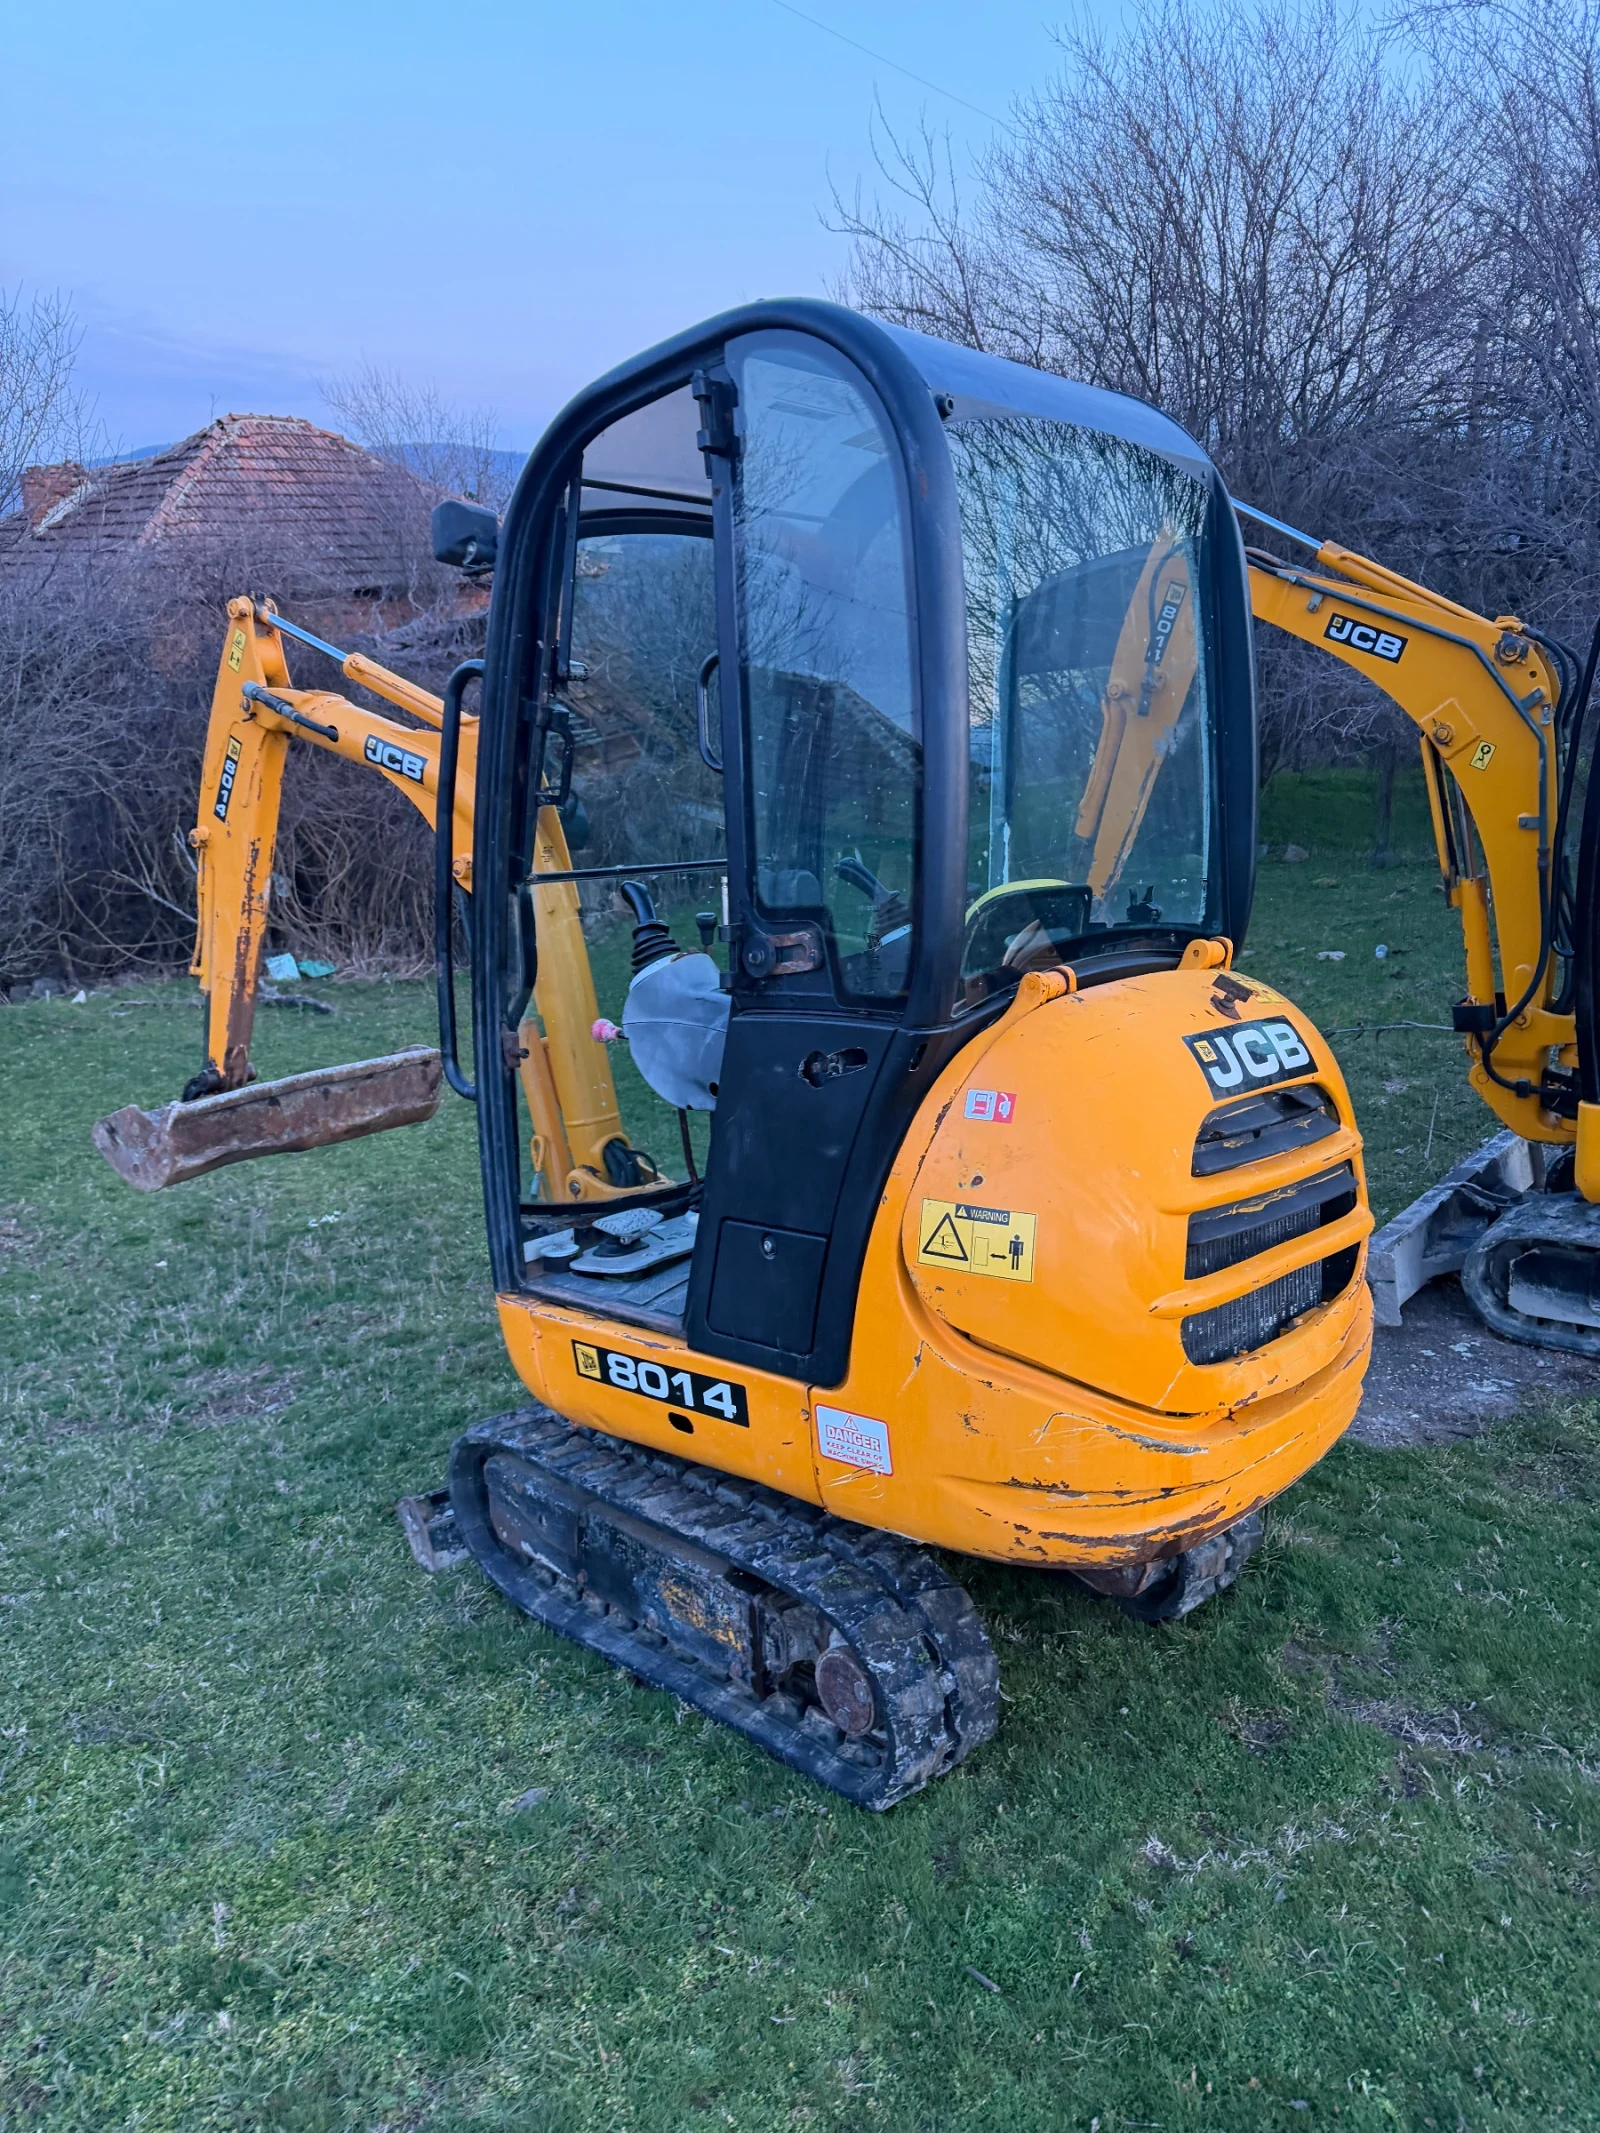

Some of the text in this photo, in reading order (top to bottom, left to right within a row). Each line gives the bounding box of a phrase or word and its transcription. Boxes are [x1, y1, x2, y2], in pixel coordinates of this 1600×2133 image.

[1329, 621, 1403, 659] JCB
[366, 742, 423, 780] JCB
[216, 760, 236, 817] 8014
[1208, 1023, 1310, 1088] JCB
[970, 1208, 1008, 1223] WARNING
[606, 1353, 737, 1419] 8014
[825, 1424, 882, 1453] DANGER
[826, 1441, 884, 1462] KEEP CLEAR OF
[826, 1449, 860, 1463] MACHINE
